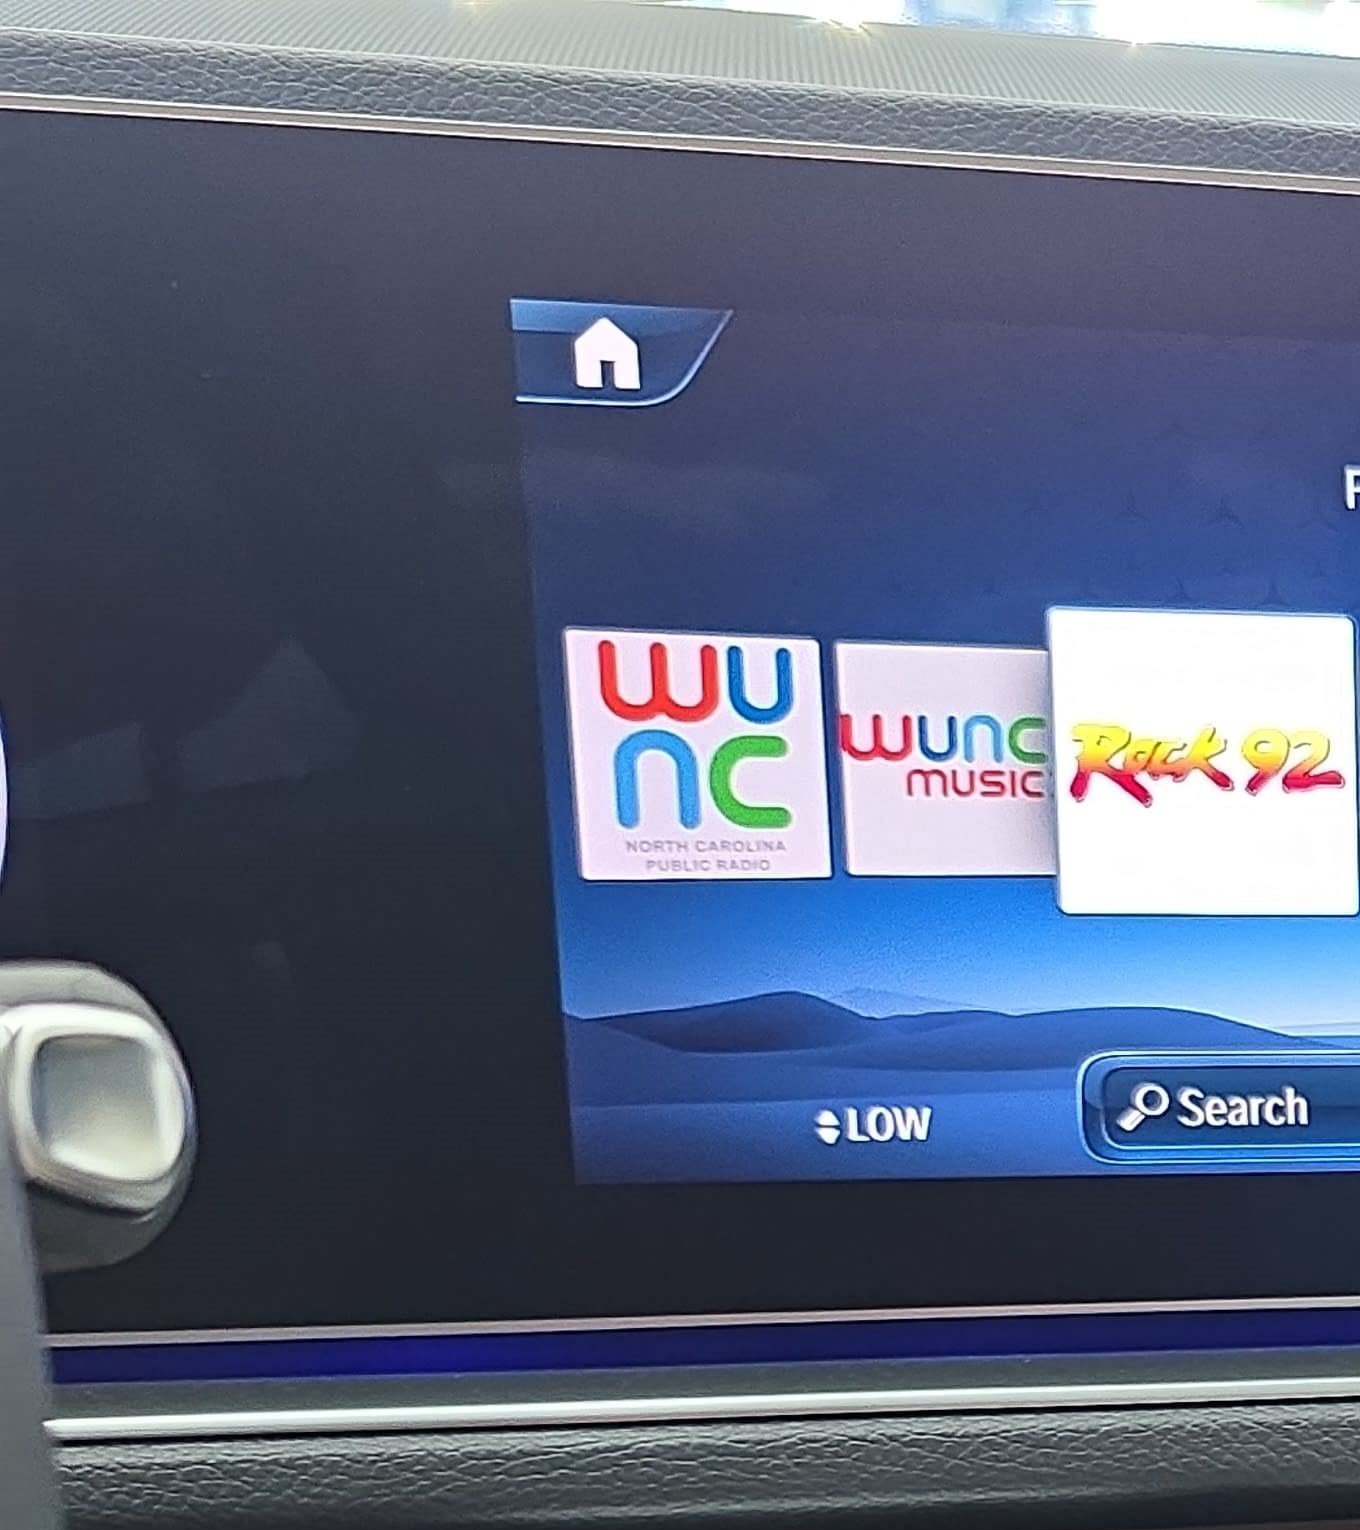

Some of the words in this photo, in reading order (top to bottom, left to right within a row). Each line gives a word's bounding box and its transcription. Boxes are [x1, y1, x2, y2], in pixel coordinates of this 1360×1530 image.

[1069, 722, 1236, 808] Rock
[1240, 727, 1346, 797] 92
[626, 840, 692, 854] NORTH
[694, 840, 788, 853] CAROLINA
[645, 859, 712, 873] PUBLIC
[715, 859, 772, 872] RADIO
[846, 1105, 933, 1142] LOW
[1177, 1085, 1310, 1128] Search
